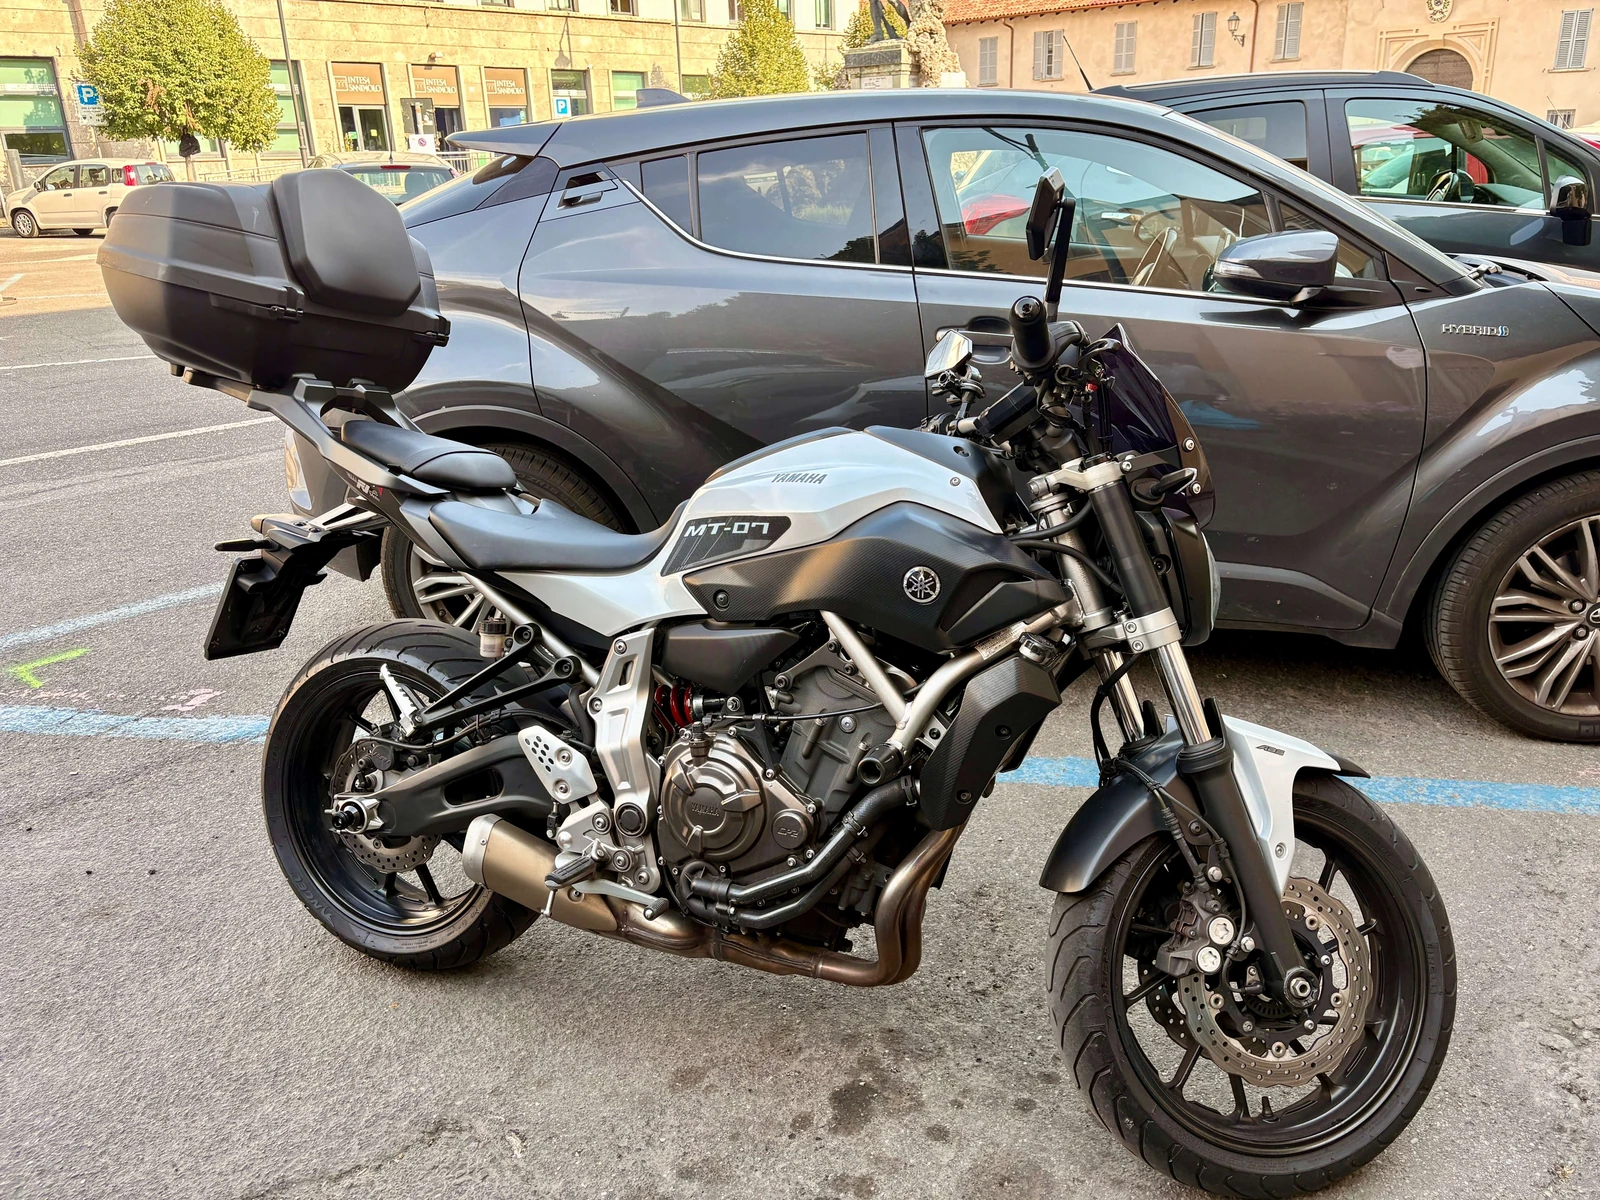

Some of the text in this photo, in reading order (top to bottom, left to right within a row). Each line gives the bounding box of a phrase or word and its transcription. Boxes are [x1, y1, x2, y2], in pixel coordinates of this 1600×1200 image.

[347, 76, 371, 85] INTESA
[425, 78, 447, 86] INTESA
[81, 87, 94, 103] P
[557, 100, 567, 113] P
[1441, 323, 1498, 336] HYBRID
[771, 473, 828, 485] YAMAHA
[684, 522, 770, 537] MT-07
[691, 802, 720, 817] YAMAHA
